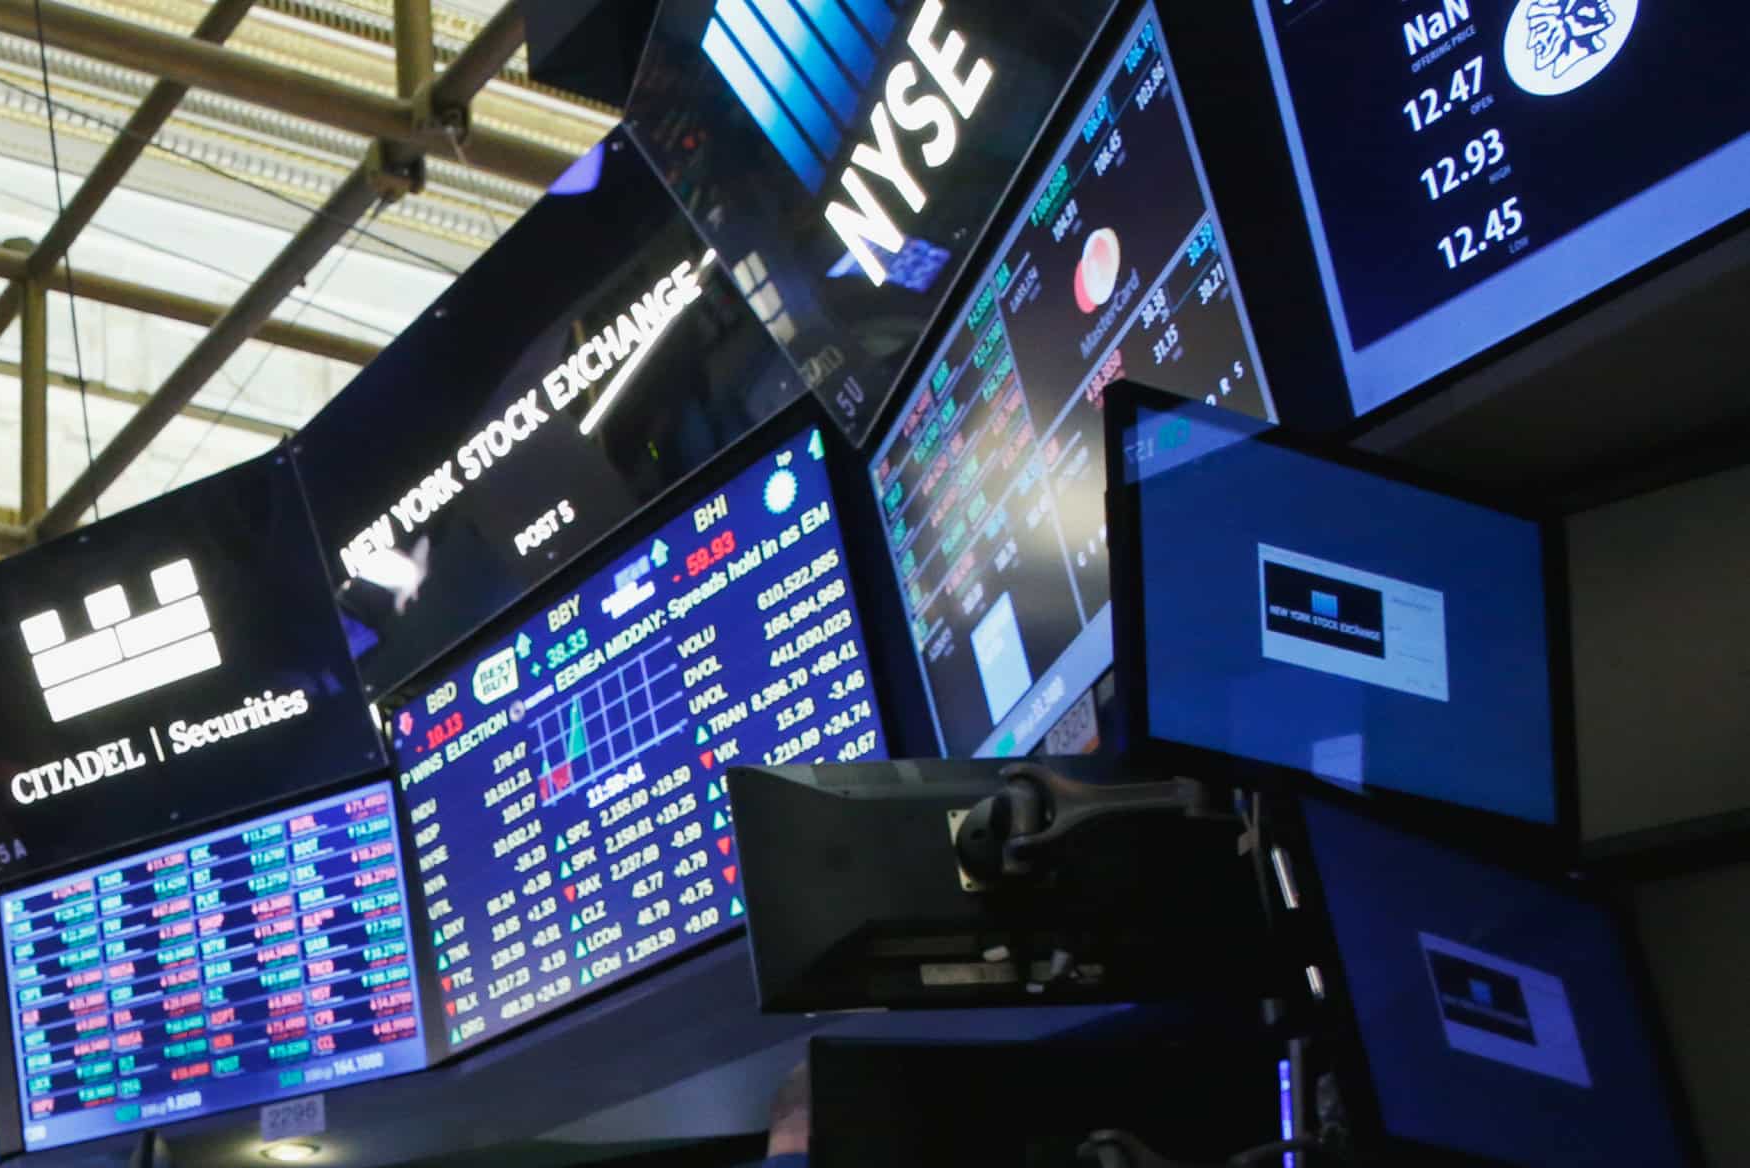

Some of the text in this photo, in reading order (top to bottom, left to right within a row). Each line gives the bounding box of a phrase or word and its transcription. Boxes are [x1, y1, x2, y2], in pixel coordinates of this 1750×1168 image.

[1403, 0, 1469, 55] NaN
[1403, 55, 1483, 131] 12.47
[824, 0, 994, 286] NYSE
[1420, 128, 1504, 200] 12.93
[1437, 196, 1523, 269] 12.45
[340, 514, 395, 577] NEW
[390, 461, 463, 533] YORK
[457, 390, 549, 480] STOCK
[542, 260, 703, 412] EXCHANGE
[514, 500, 576, 556] POST 5
[693, 493, 728, 533] BHI
[667, 571, 728, 620] Spreads
[726, 544, 762, 581] hold
[761, 538, 779, 559] in
[779, 524, 801, 549] as
[800, 501, 830, 535] EM
[685, 530, 736, 577] 59.93
[547, 593, 580, 633] BBY
[1269, 604, 1289, 617] NEW
[1290, 609, 1312, 624] YORK
[1312, 615, 1339, 631] STOCK
[480, 659, 512, 683] BEST
[482, 675, 510, 697] BUY
[445, 709, 509, 762] ELECTION
[707, 701, 748, 736] TRAN
[11, 688, 309, 806] CITADEL Securities
